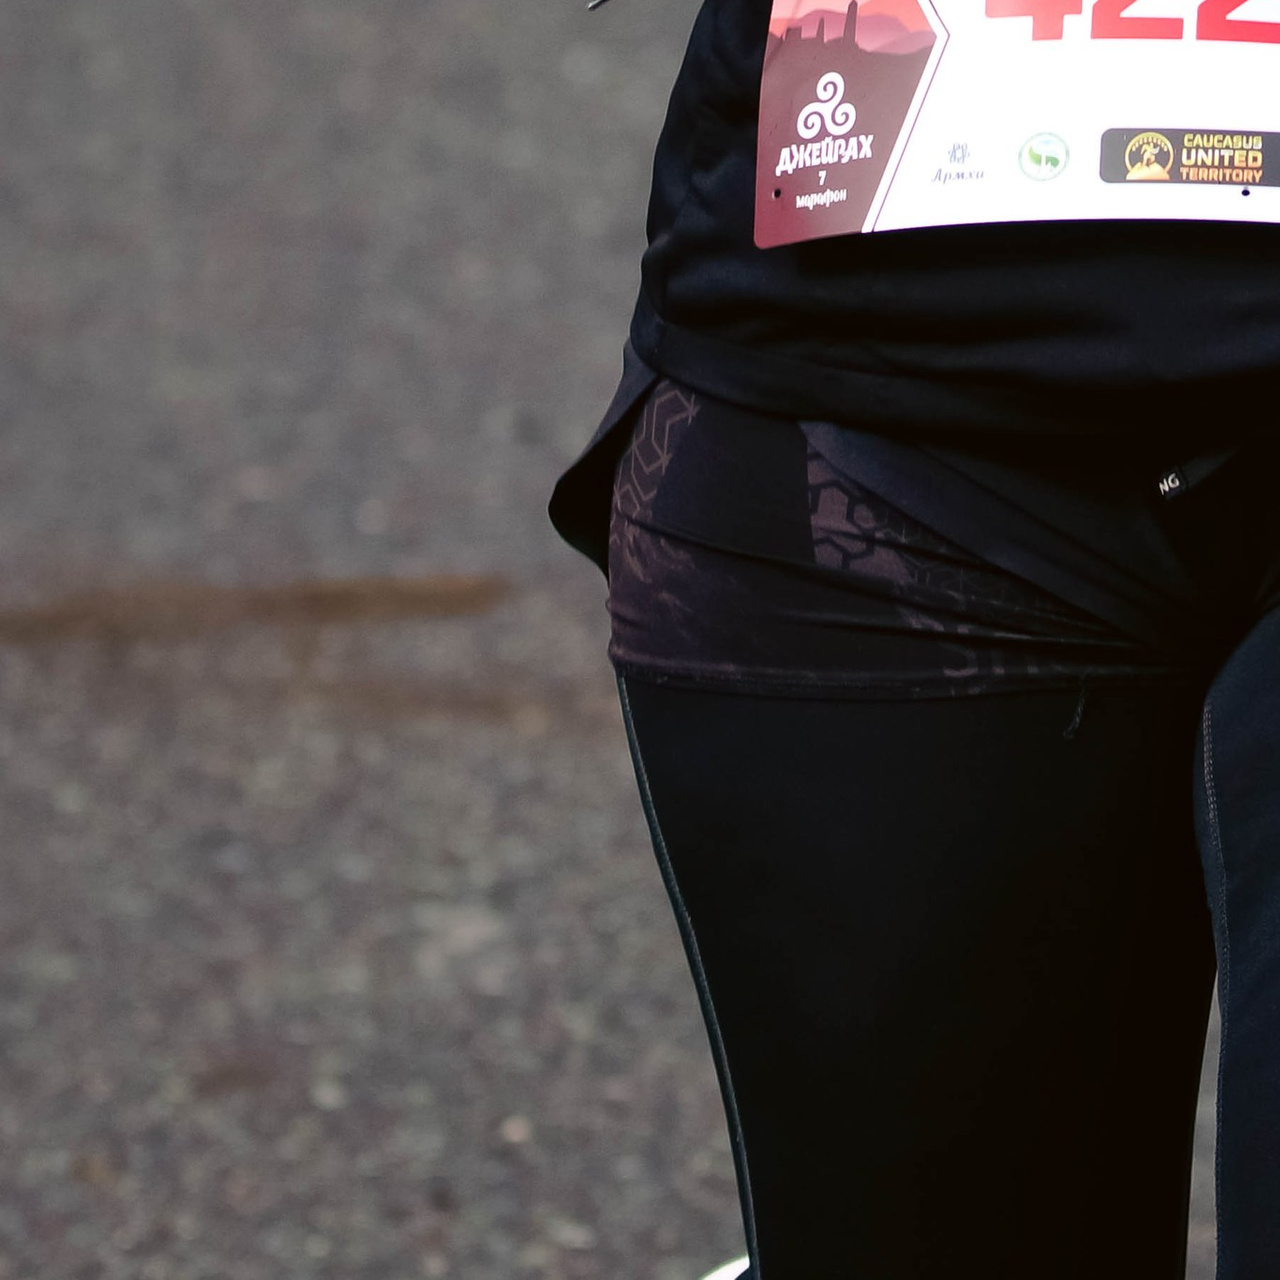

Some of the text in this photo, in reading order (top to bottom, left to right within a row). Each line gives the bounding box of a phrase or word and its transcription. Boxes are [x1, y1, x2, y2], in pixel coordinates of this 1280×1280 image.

[1183, 133, 1263, 149] CAUCASUS
[775, 134, 874, 176] ДЖЕЙРАХ
[1181, 148, 1263, 167] UNITED
[1180, 167, 1263, 183] TERRITORY
[795, 188, 847, 210] марафон
